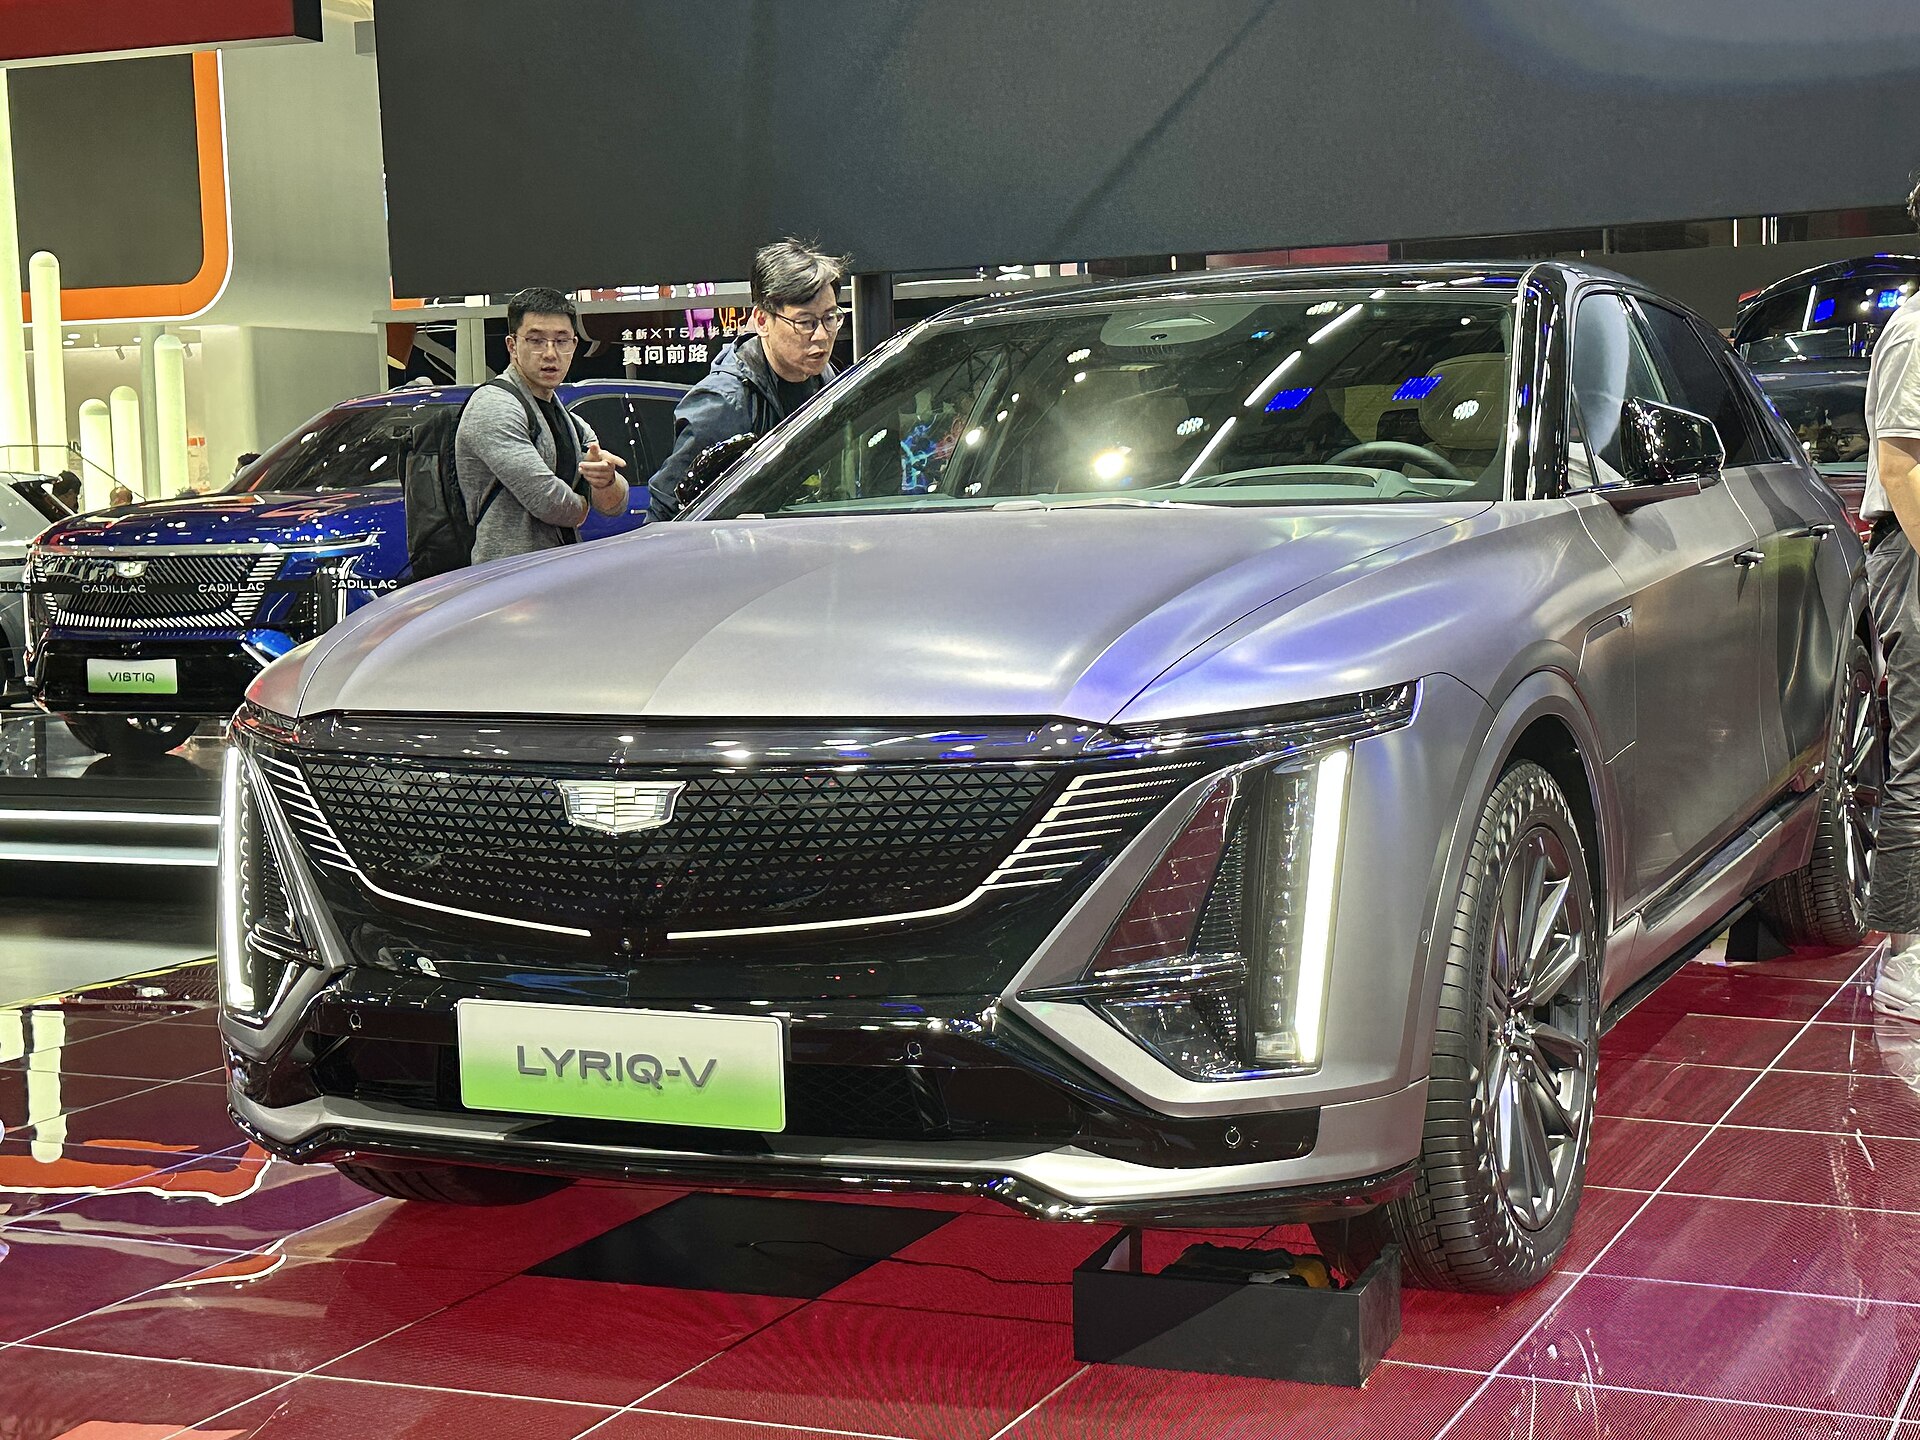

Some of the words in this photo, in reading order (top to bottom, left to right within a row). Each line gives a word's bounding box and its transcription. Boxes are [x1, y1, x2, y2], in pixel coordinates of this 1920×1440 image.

[622, 344, 708, 366] 莫问前路
[81, 584, 147, 593] CADILLAC
[198, 582, 266, 593] CADILLAC
[516, 1045, 718, 1090] LYRIQ-V
